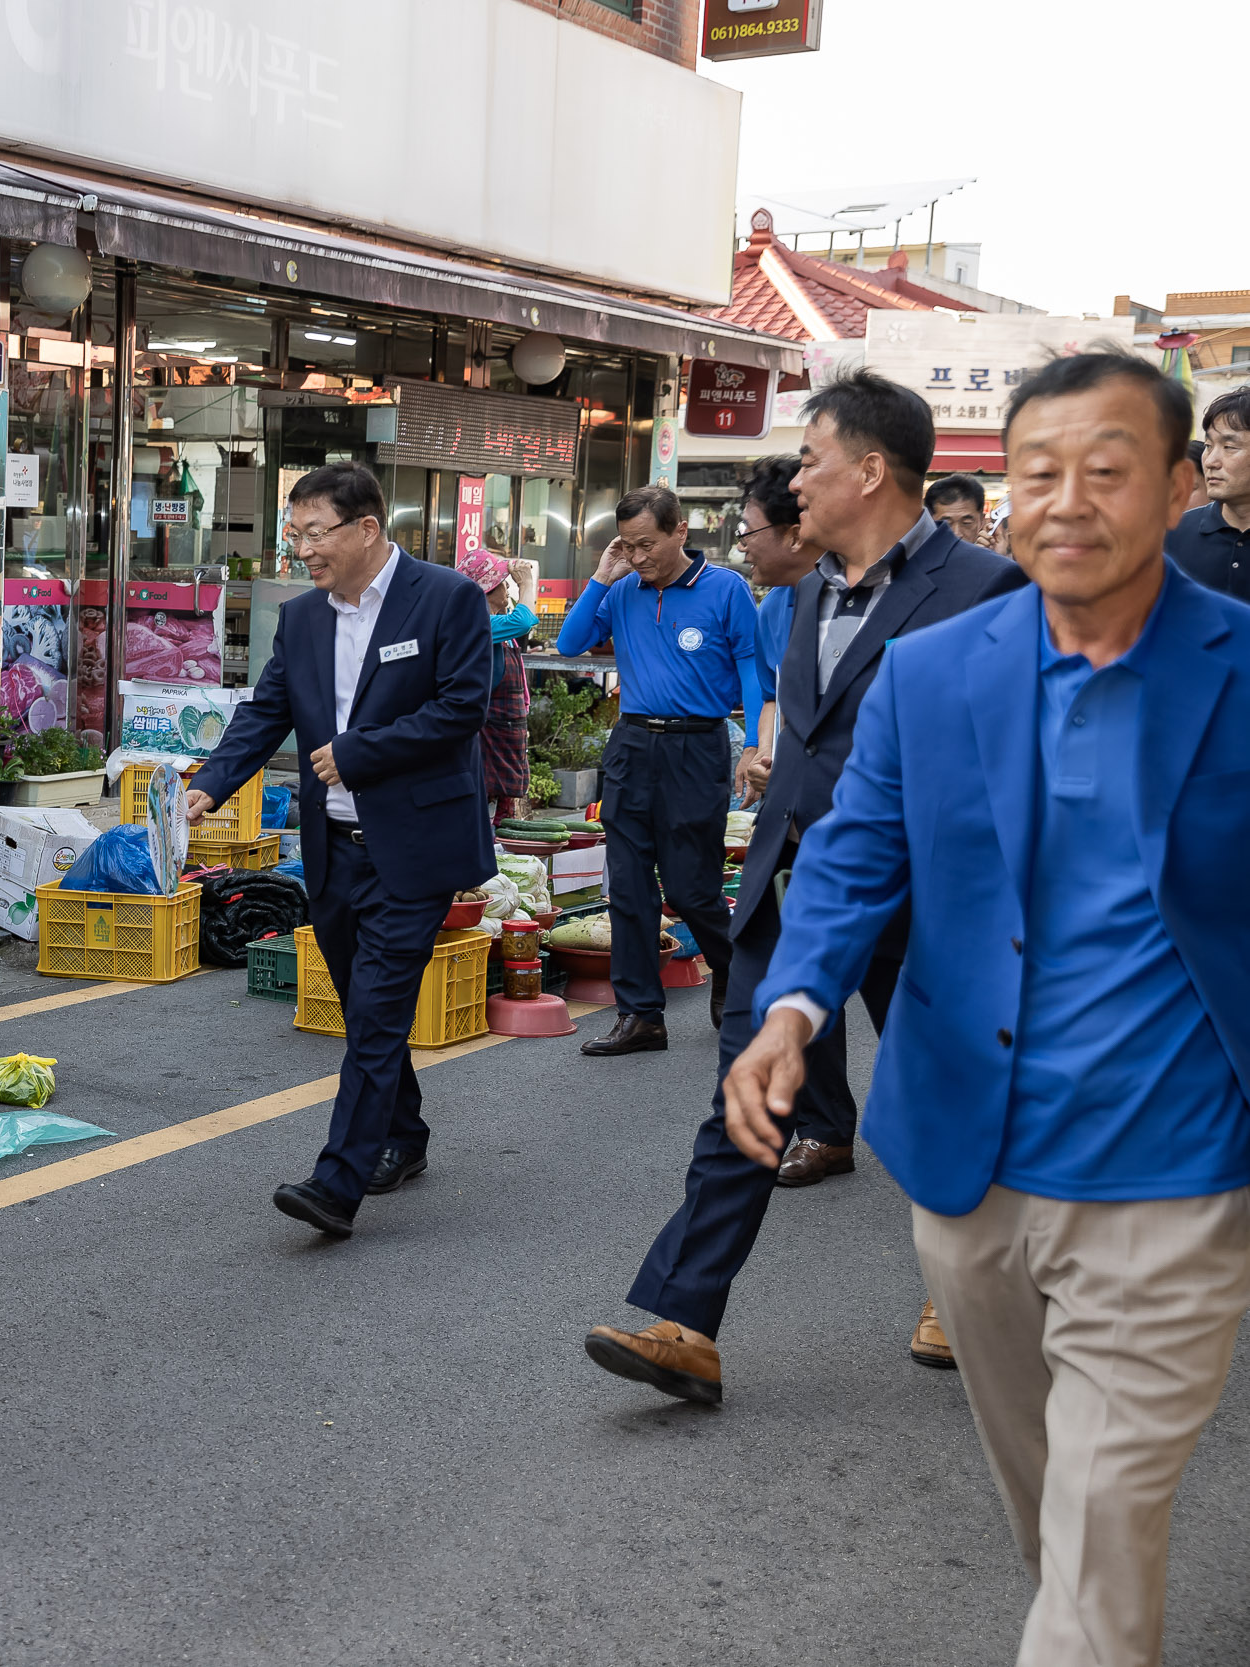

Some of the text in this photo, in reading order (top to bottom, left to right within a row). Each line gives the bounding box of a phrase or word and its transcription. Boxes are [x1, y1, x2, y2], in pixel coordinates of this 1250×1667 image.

[711, 18, 800, 40] 061)864.9333
[123, 0, 344, 129] 피앤씨푸드
[699, 389, 757, 402] 피앤씨푸드
[718, 412, 732, 426] 11
[461, 486, 482, 505] 매일
[155, 502, 185, 512] 냉·난방중
[461, 512, 480, 550] 생
[133, 716, 171, 733] 쌈배추
